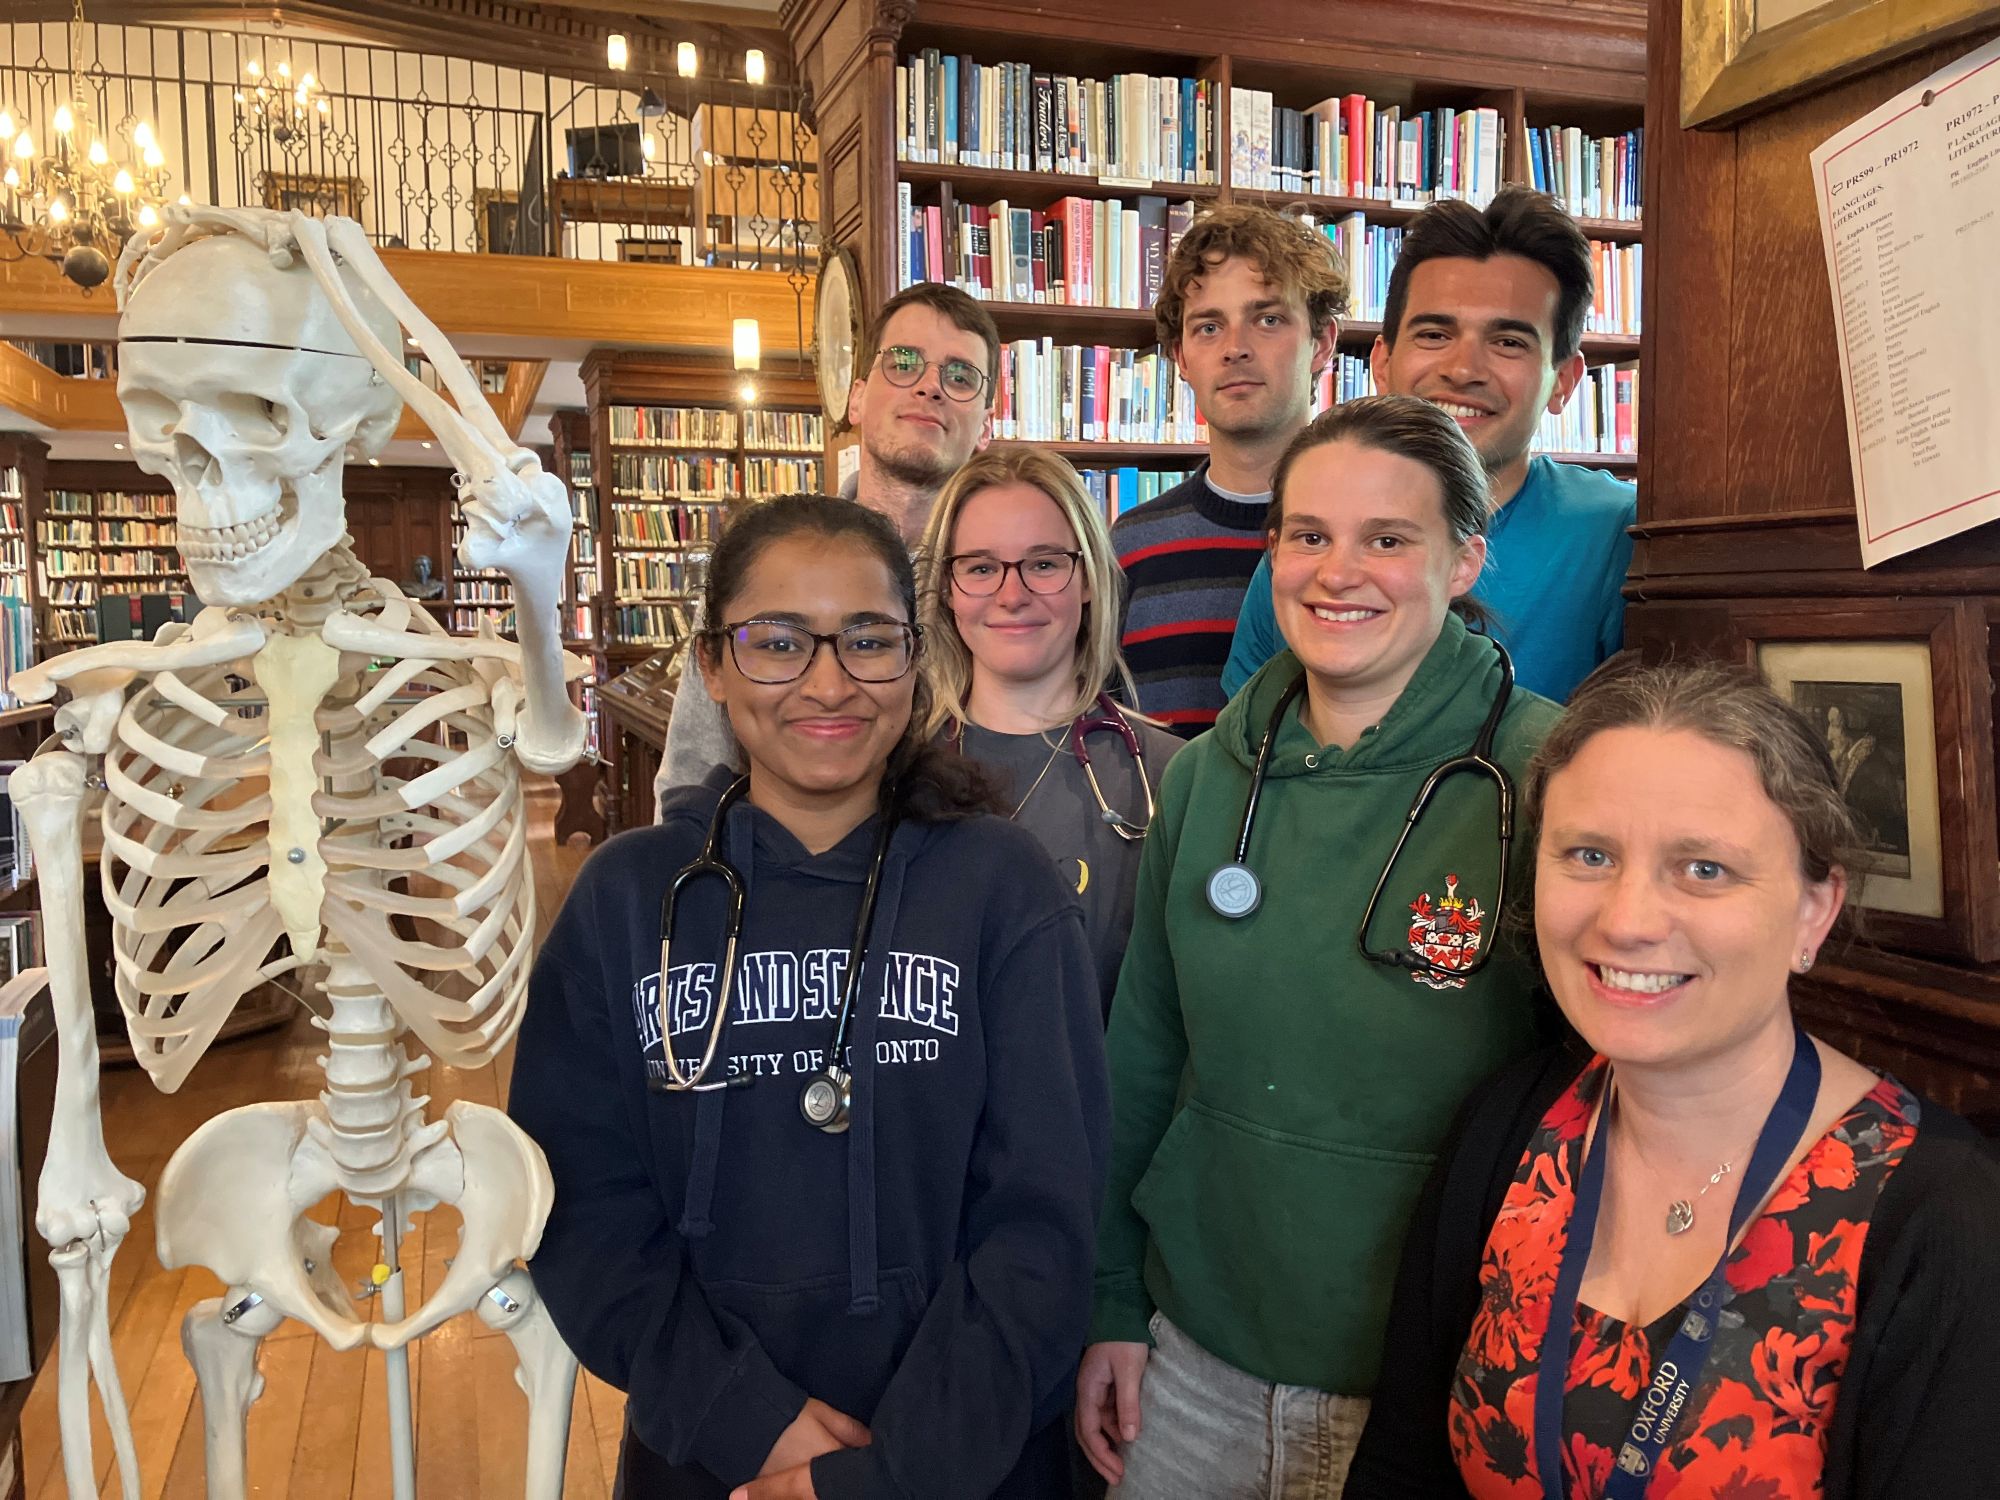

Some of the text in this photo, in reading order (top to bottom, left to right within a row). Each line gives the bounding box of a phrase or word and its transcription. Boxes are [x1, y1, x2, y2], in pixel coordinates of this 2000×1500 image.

[1038, 87, 1052, 149] Fowler's
[1946, 104, 1983, 131] PR1972
[1846, 166, 1874, 189] PR599
[1884, 140, 1919, 166] PR1972
[803, 949, 959, 1036] SCNCE
[793, 1050, 823, 1073] OF
[1632, 1361, 1678, 1442] OXFORD
[1653, 1378, 1690, 1445] UNIVERSITY
